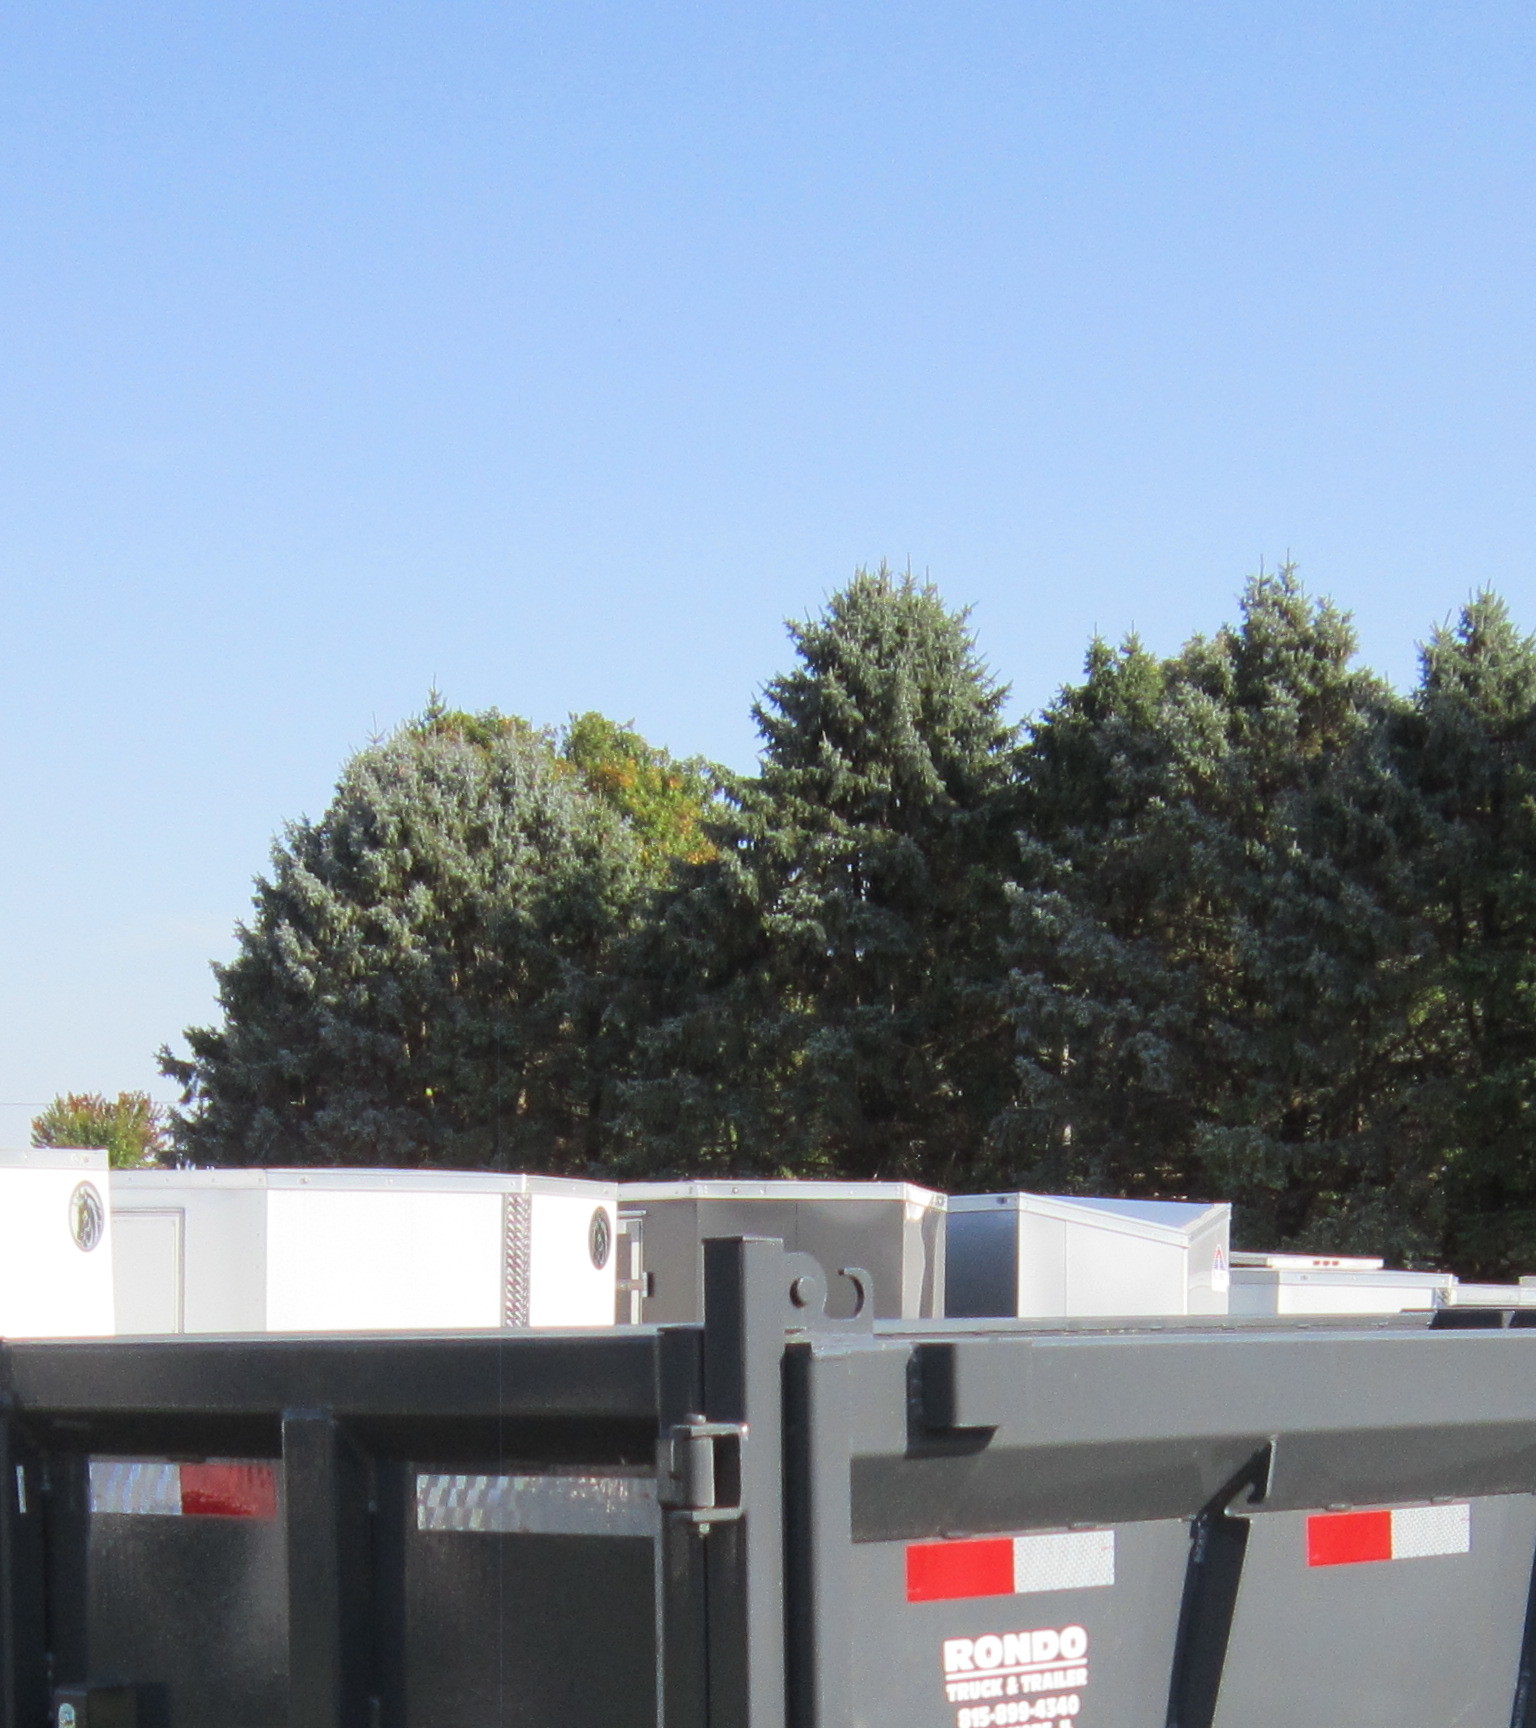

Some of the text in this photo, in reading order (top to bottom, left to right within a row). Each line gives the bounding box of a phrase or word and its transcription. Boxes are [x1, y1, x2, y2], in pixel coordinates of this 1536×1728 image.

[943, 1625, 1088, 1673] RONDO
[945, 1667, 1088, 1703] TRUCK & TRAILER
